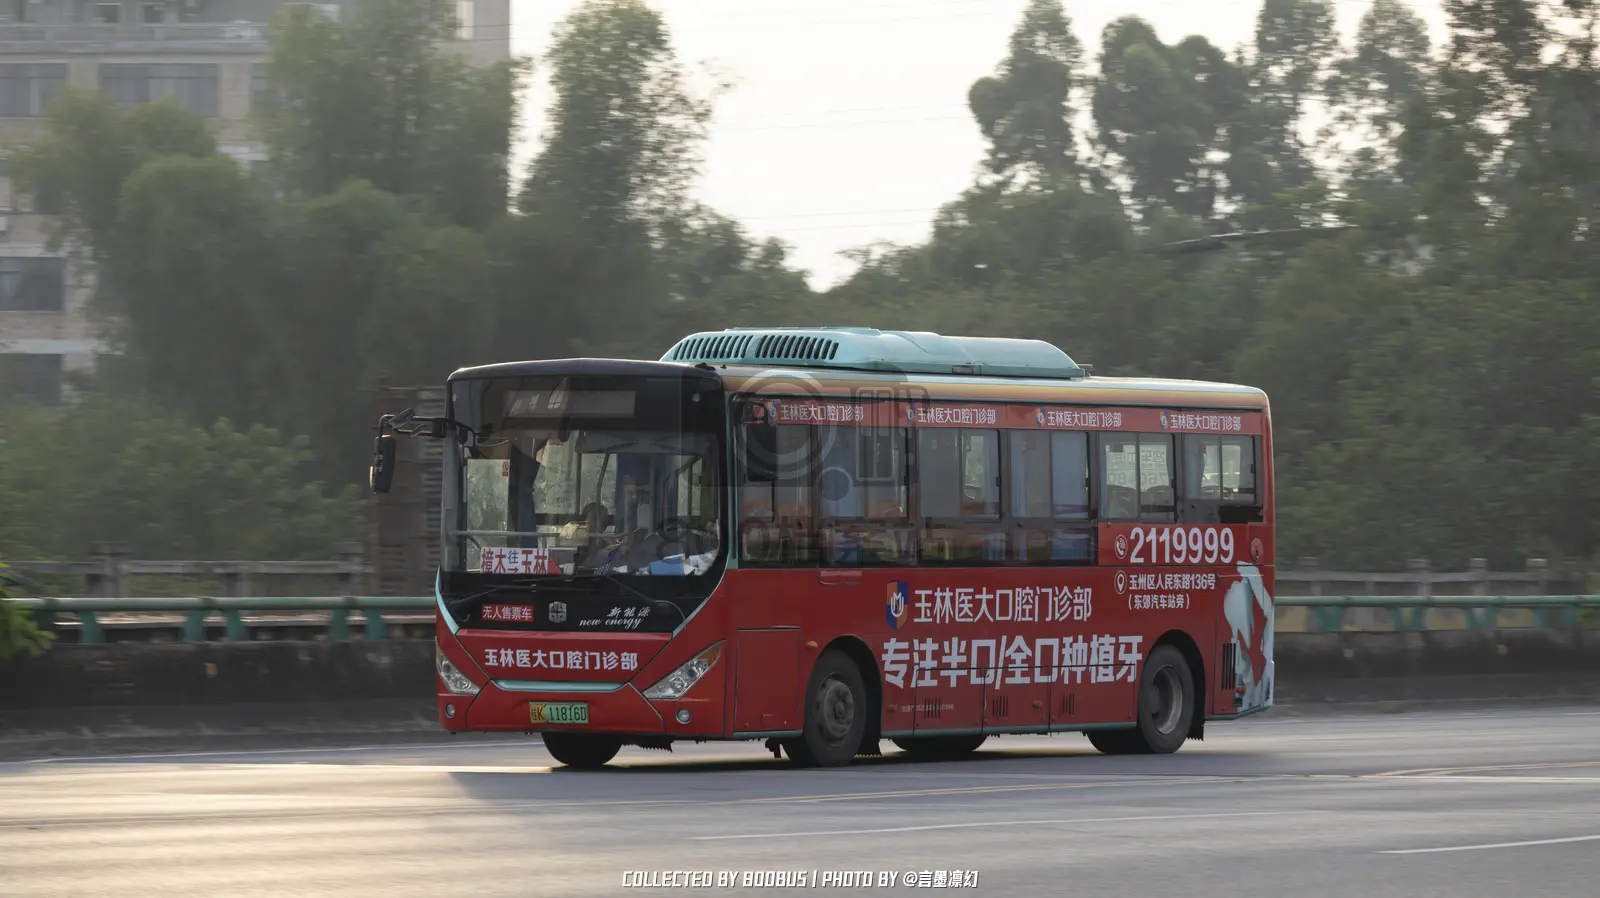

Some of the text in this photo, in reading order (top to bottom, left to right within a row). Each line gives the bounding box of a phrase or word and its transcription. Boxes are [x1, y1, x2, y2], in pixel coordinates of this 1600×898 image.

[780, 404, 864, 422] 玉林医大口腔门诊部
[917, 407, 997, 425] 玉林医大口腔门诊部
[1047, 411, 1122, 428] 玉林医大口腔门诊部
[1170, 414, 1242, 431] 玉林医大口腔门诊部
[1129, 527, 1235, 564] 2119999
[1128, 573, 1216, 590] 玉州区人民东路136号
[482, 605, 533, 621] 无人售票车
[606, 606, 651, 618] 新能源
[913, 586, 1093, 624] 玉林医大口腔门诊部
[579, 617, 645, 630] new energy
[484, 648, 638, 671] 玉林医大口腔门诊部
[881, 634, 1143, 690] 专注半口/全口种植牙
